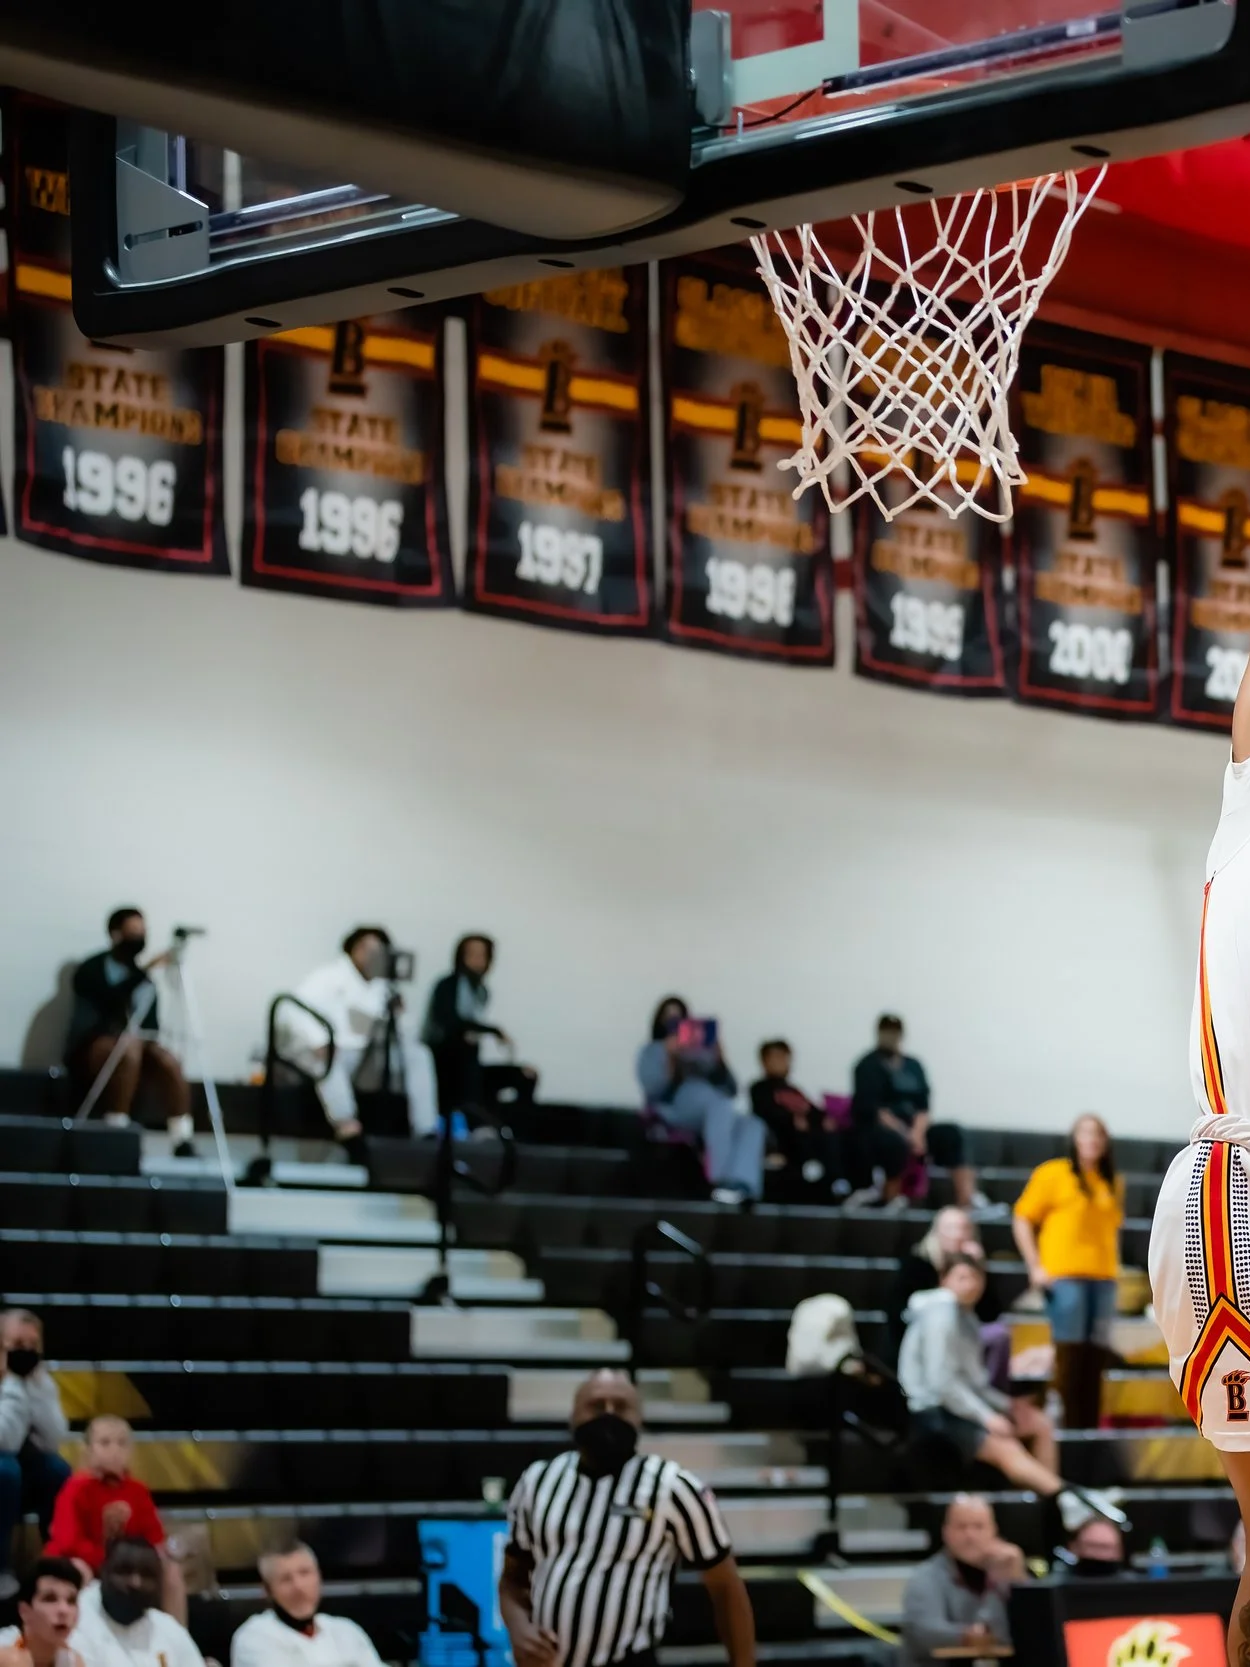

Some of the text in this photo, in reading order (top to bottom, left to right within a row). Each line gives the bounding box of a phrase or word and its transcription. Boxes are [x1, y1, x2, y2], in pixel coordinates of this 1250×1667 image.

[62, 445, 177, 527] 1996
[298, 486, 404, 564] 1996
[515, 520, 603, 595] 1997
